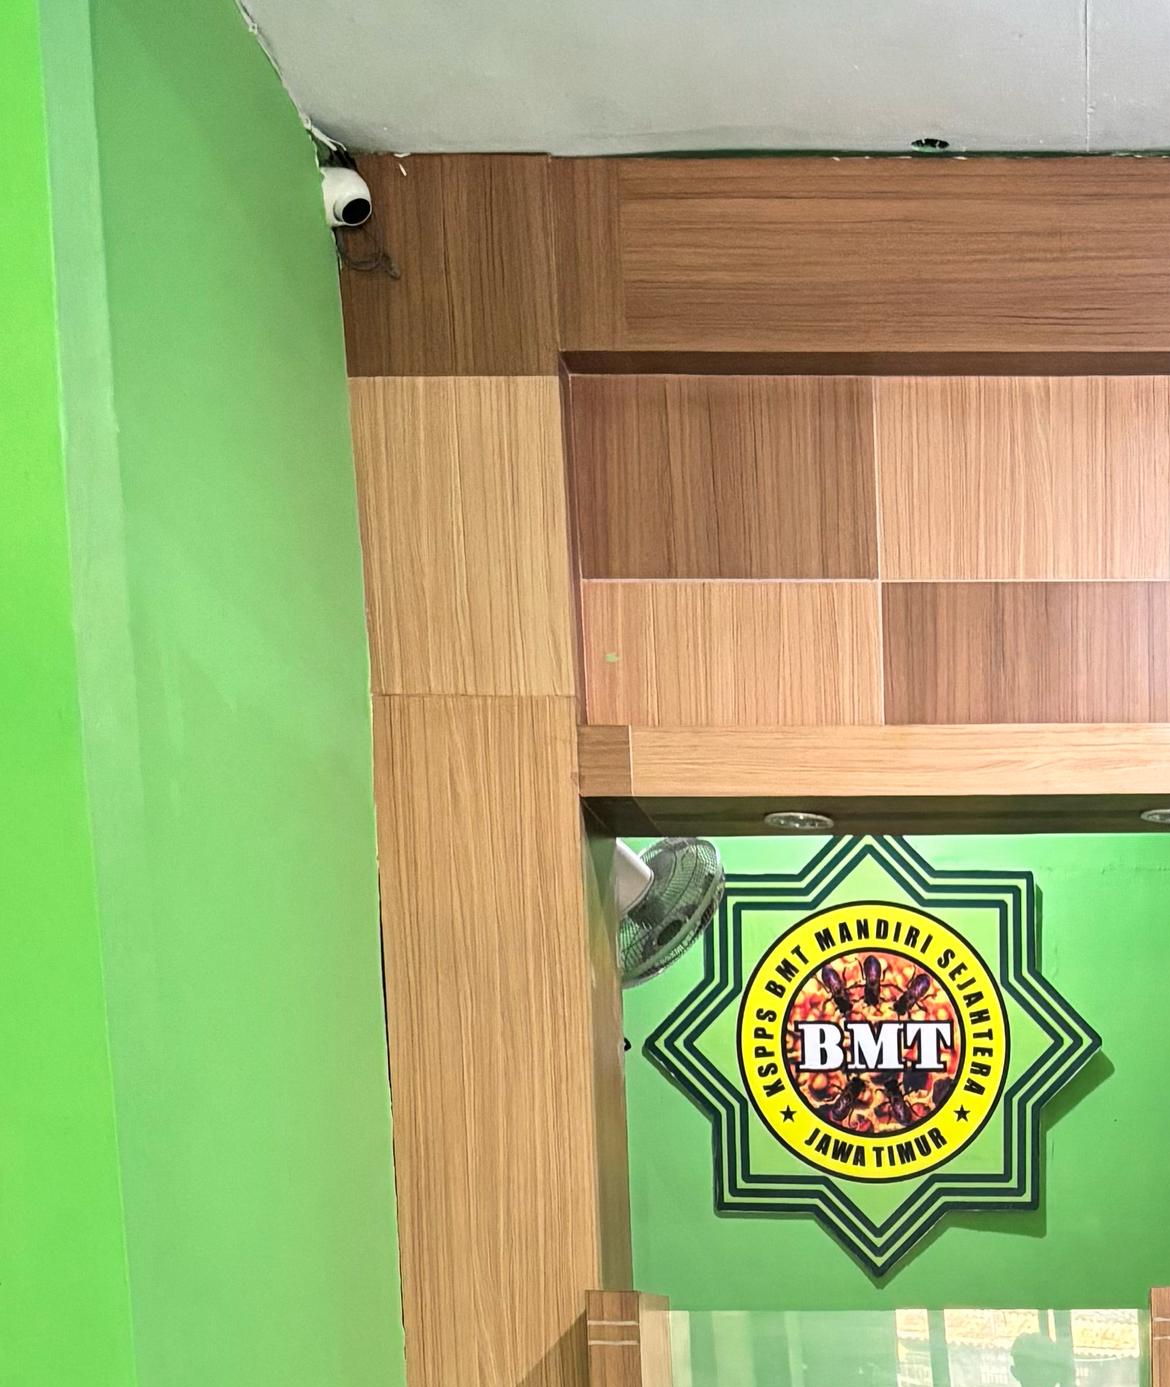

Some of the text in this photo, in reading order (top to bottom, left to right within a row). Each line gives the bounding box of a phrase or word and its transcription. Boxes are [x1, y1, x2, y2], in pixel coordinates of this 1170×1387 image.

[754, 918, 994, 1097] KSPPS BMT MANDIRI SEJAHTERA
[797, 1021, 951, 1071] BMT
[804, 1126, 949, 1167] JAWA TIMUR
